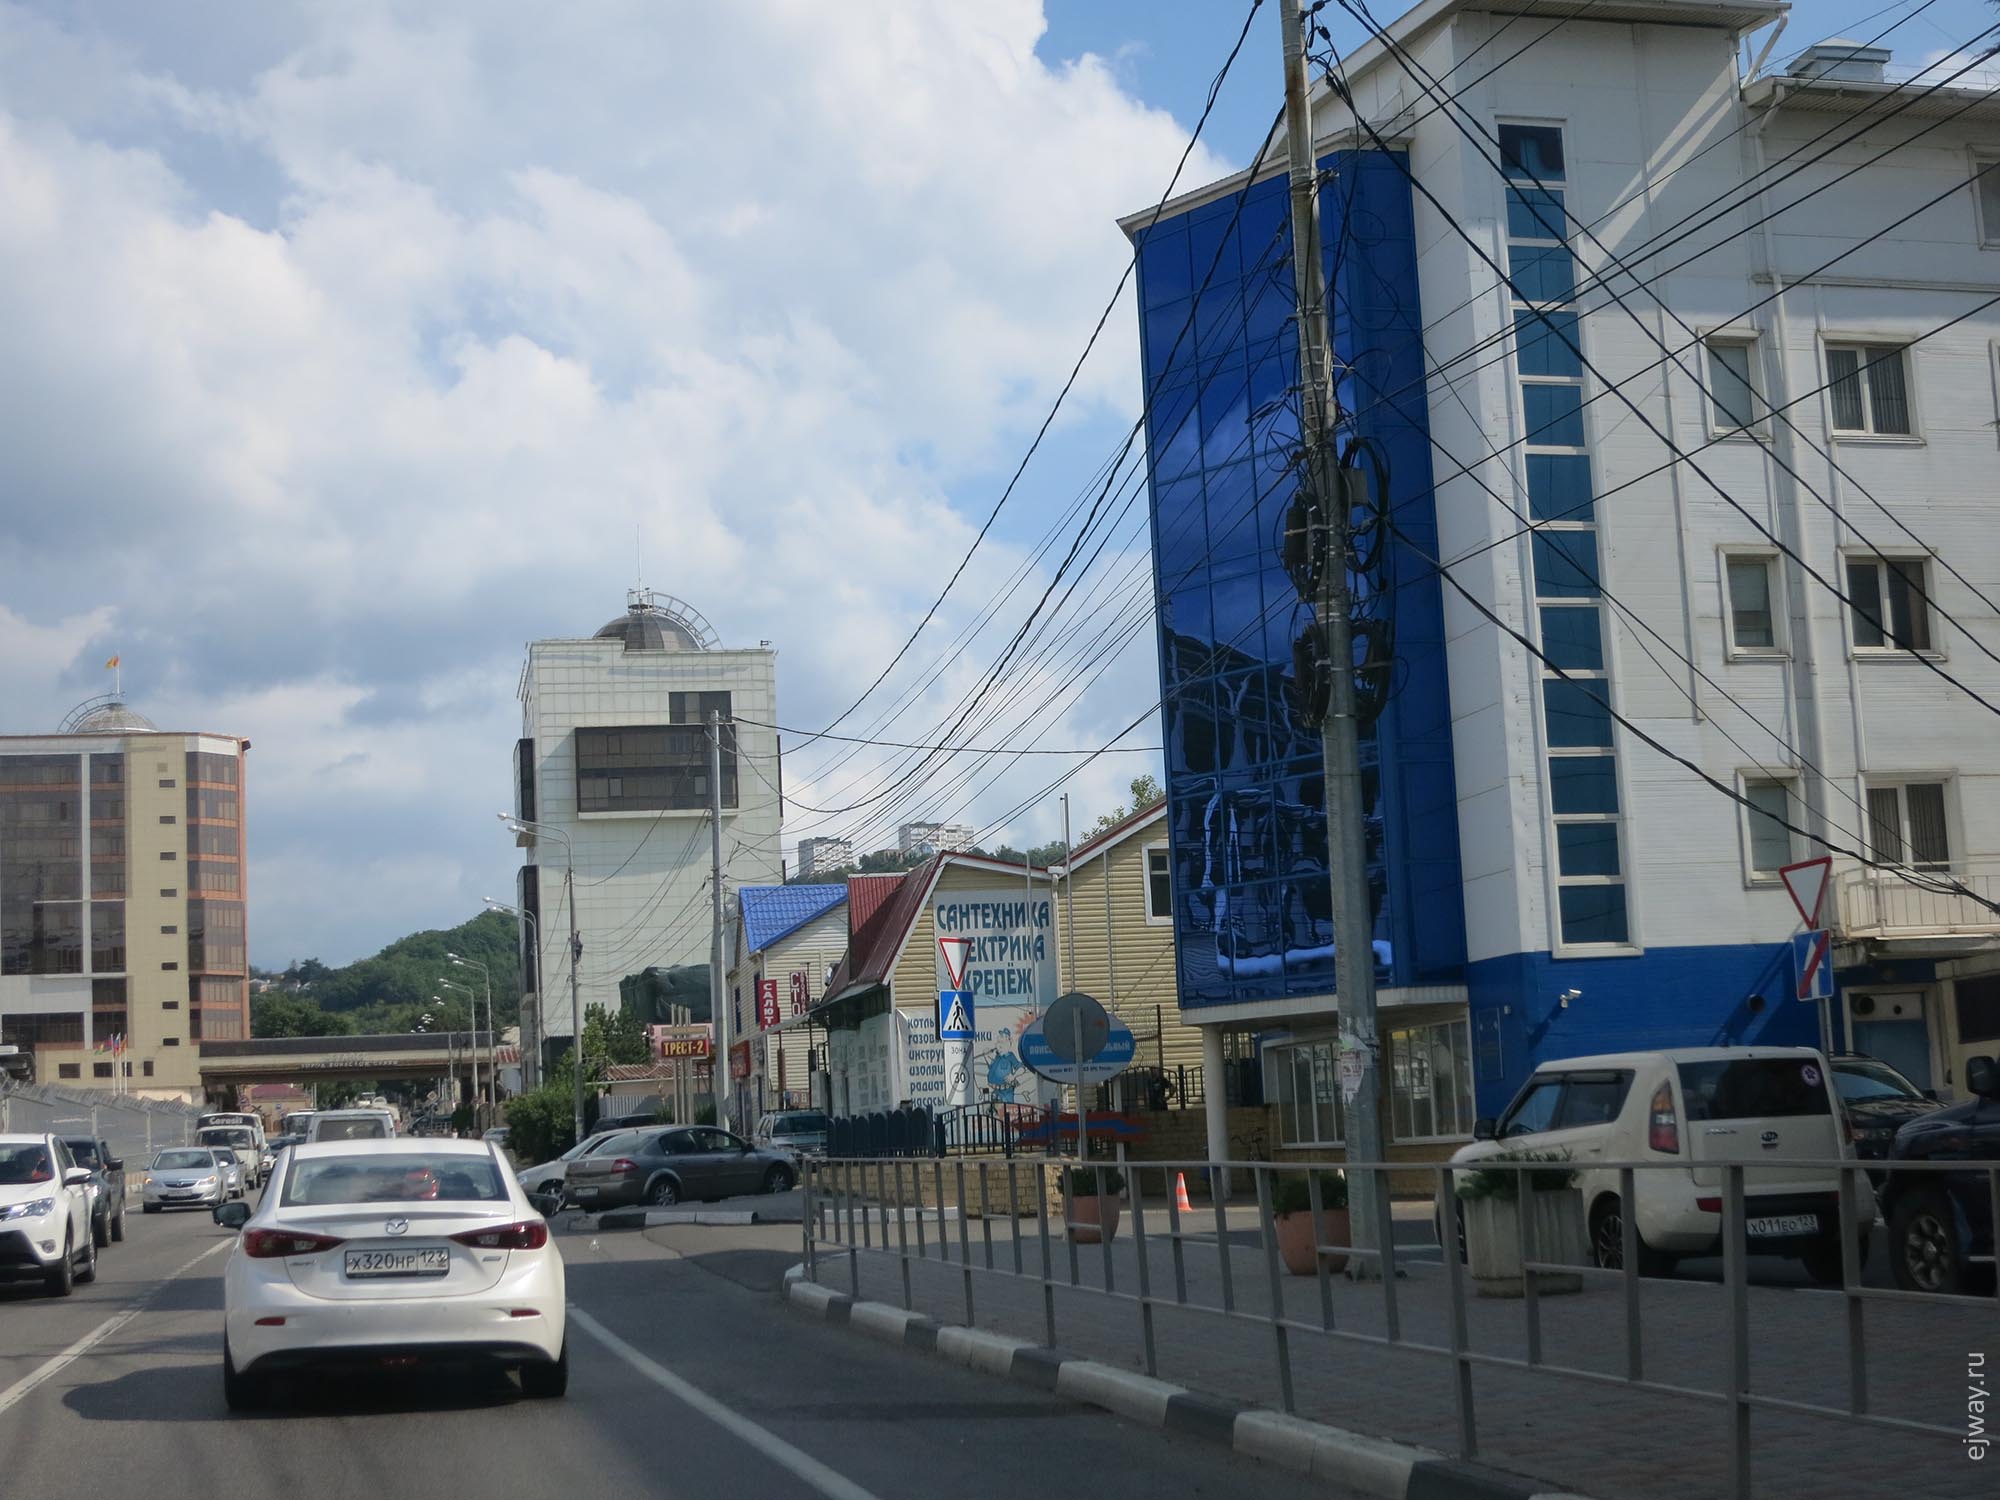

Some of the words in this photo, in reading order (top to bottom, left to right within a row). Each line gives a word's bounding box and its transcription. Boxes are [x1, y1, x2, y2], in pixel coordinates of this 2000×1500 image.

[937, 901, 1049, 933] САНТЕХНИКА
[961, 934, 1045, 962] ЕКТРИКА
[962, 962, 1033, 997] КРЕПЁЖ
[790, 972, 801, 1017] СТО
[663, 1040, 704, 1056] ТРЕСТ-2
[910, 1081, 944, 1094] радиат
[954, 1072, 966, 1083] 30
[420, 1250, 446, 1264] 123
